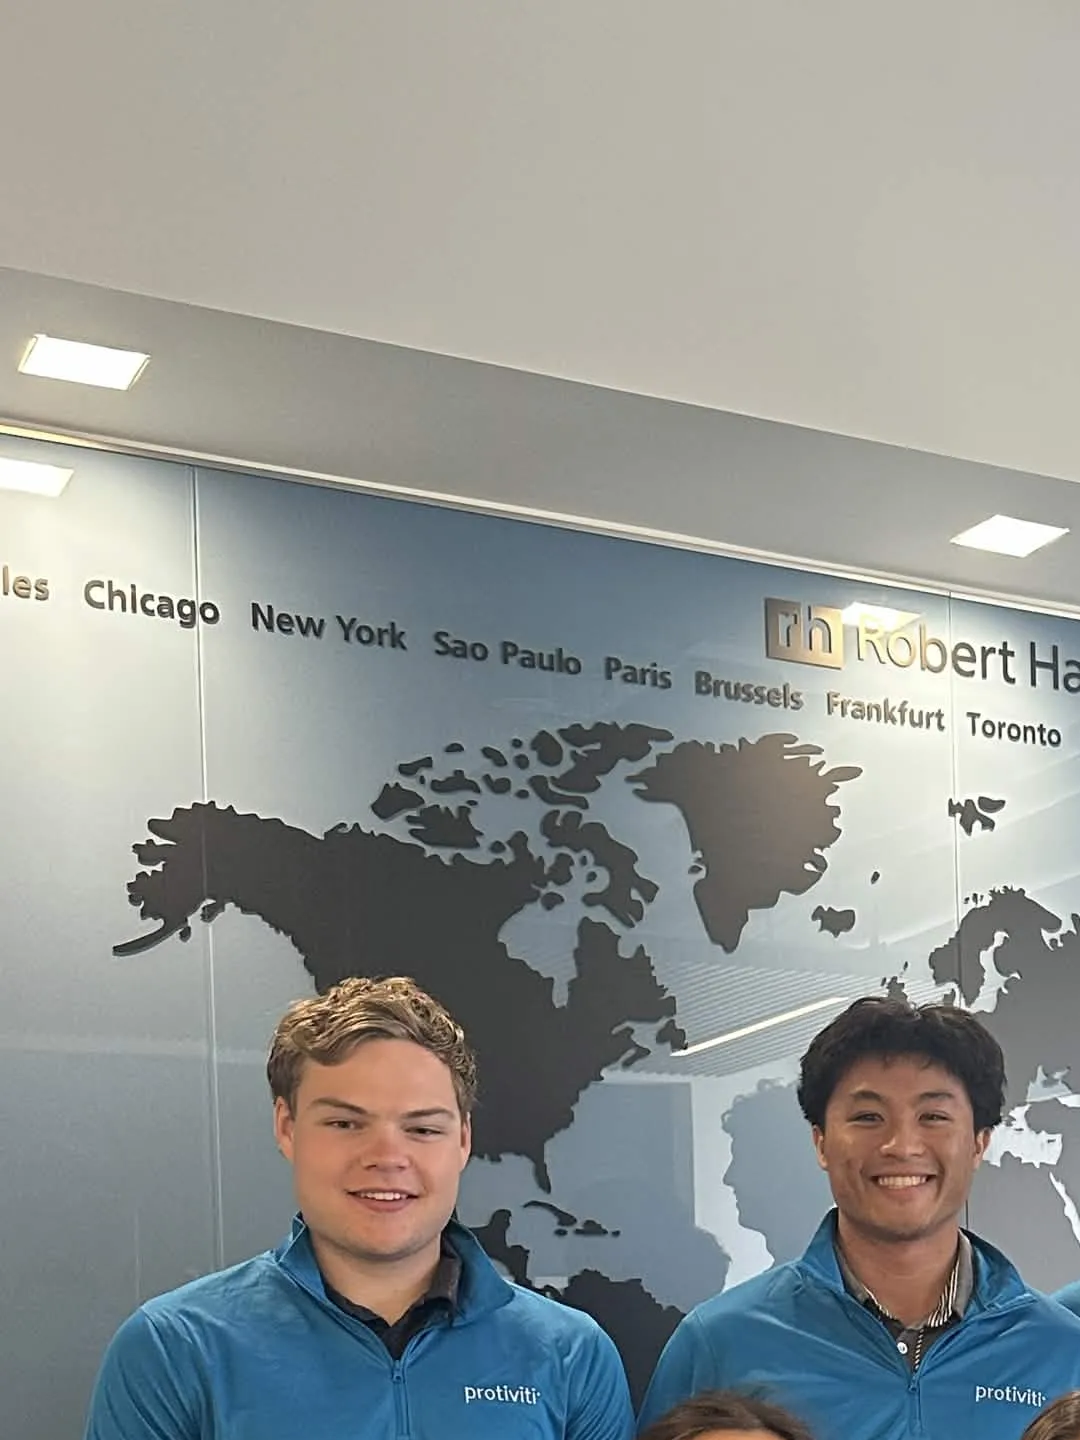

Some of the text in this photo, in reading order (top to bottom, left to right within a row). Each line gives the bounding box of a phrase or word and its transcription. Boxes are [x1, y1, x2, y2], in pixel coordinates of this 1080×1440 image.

[84, 579, 220, 629] Chicago
[251, 602, 325, 639] New
[335, 615, 407, 651] York
[433, 631, 488, 661] Sao
[501, 641, 581, 675] Paulo
[604, 656, 672, 689] Paris
[694, 670, 804, 710] Brussels
[827, 691, 945, 731] Frankfurt
[966, 711, 1061, 747] Toronto
[777, 600, 833, 654] rh
[857, 613, 1016, 684] Robert
[464, 1385, 538, 1404] protiviti
[975, 1385, 1043, 1407] protiviti
